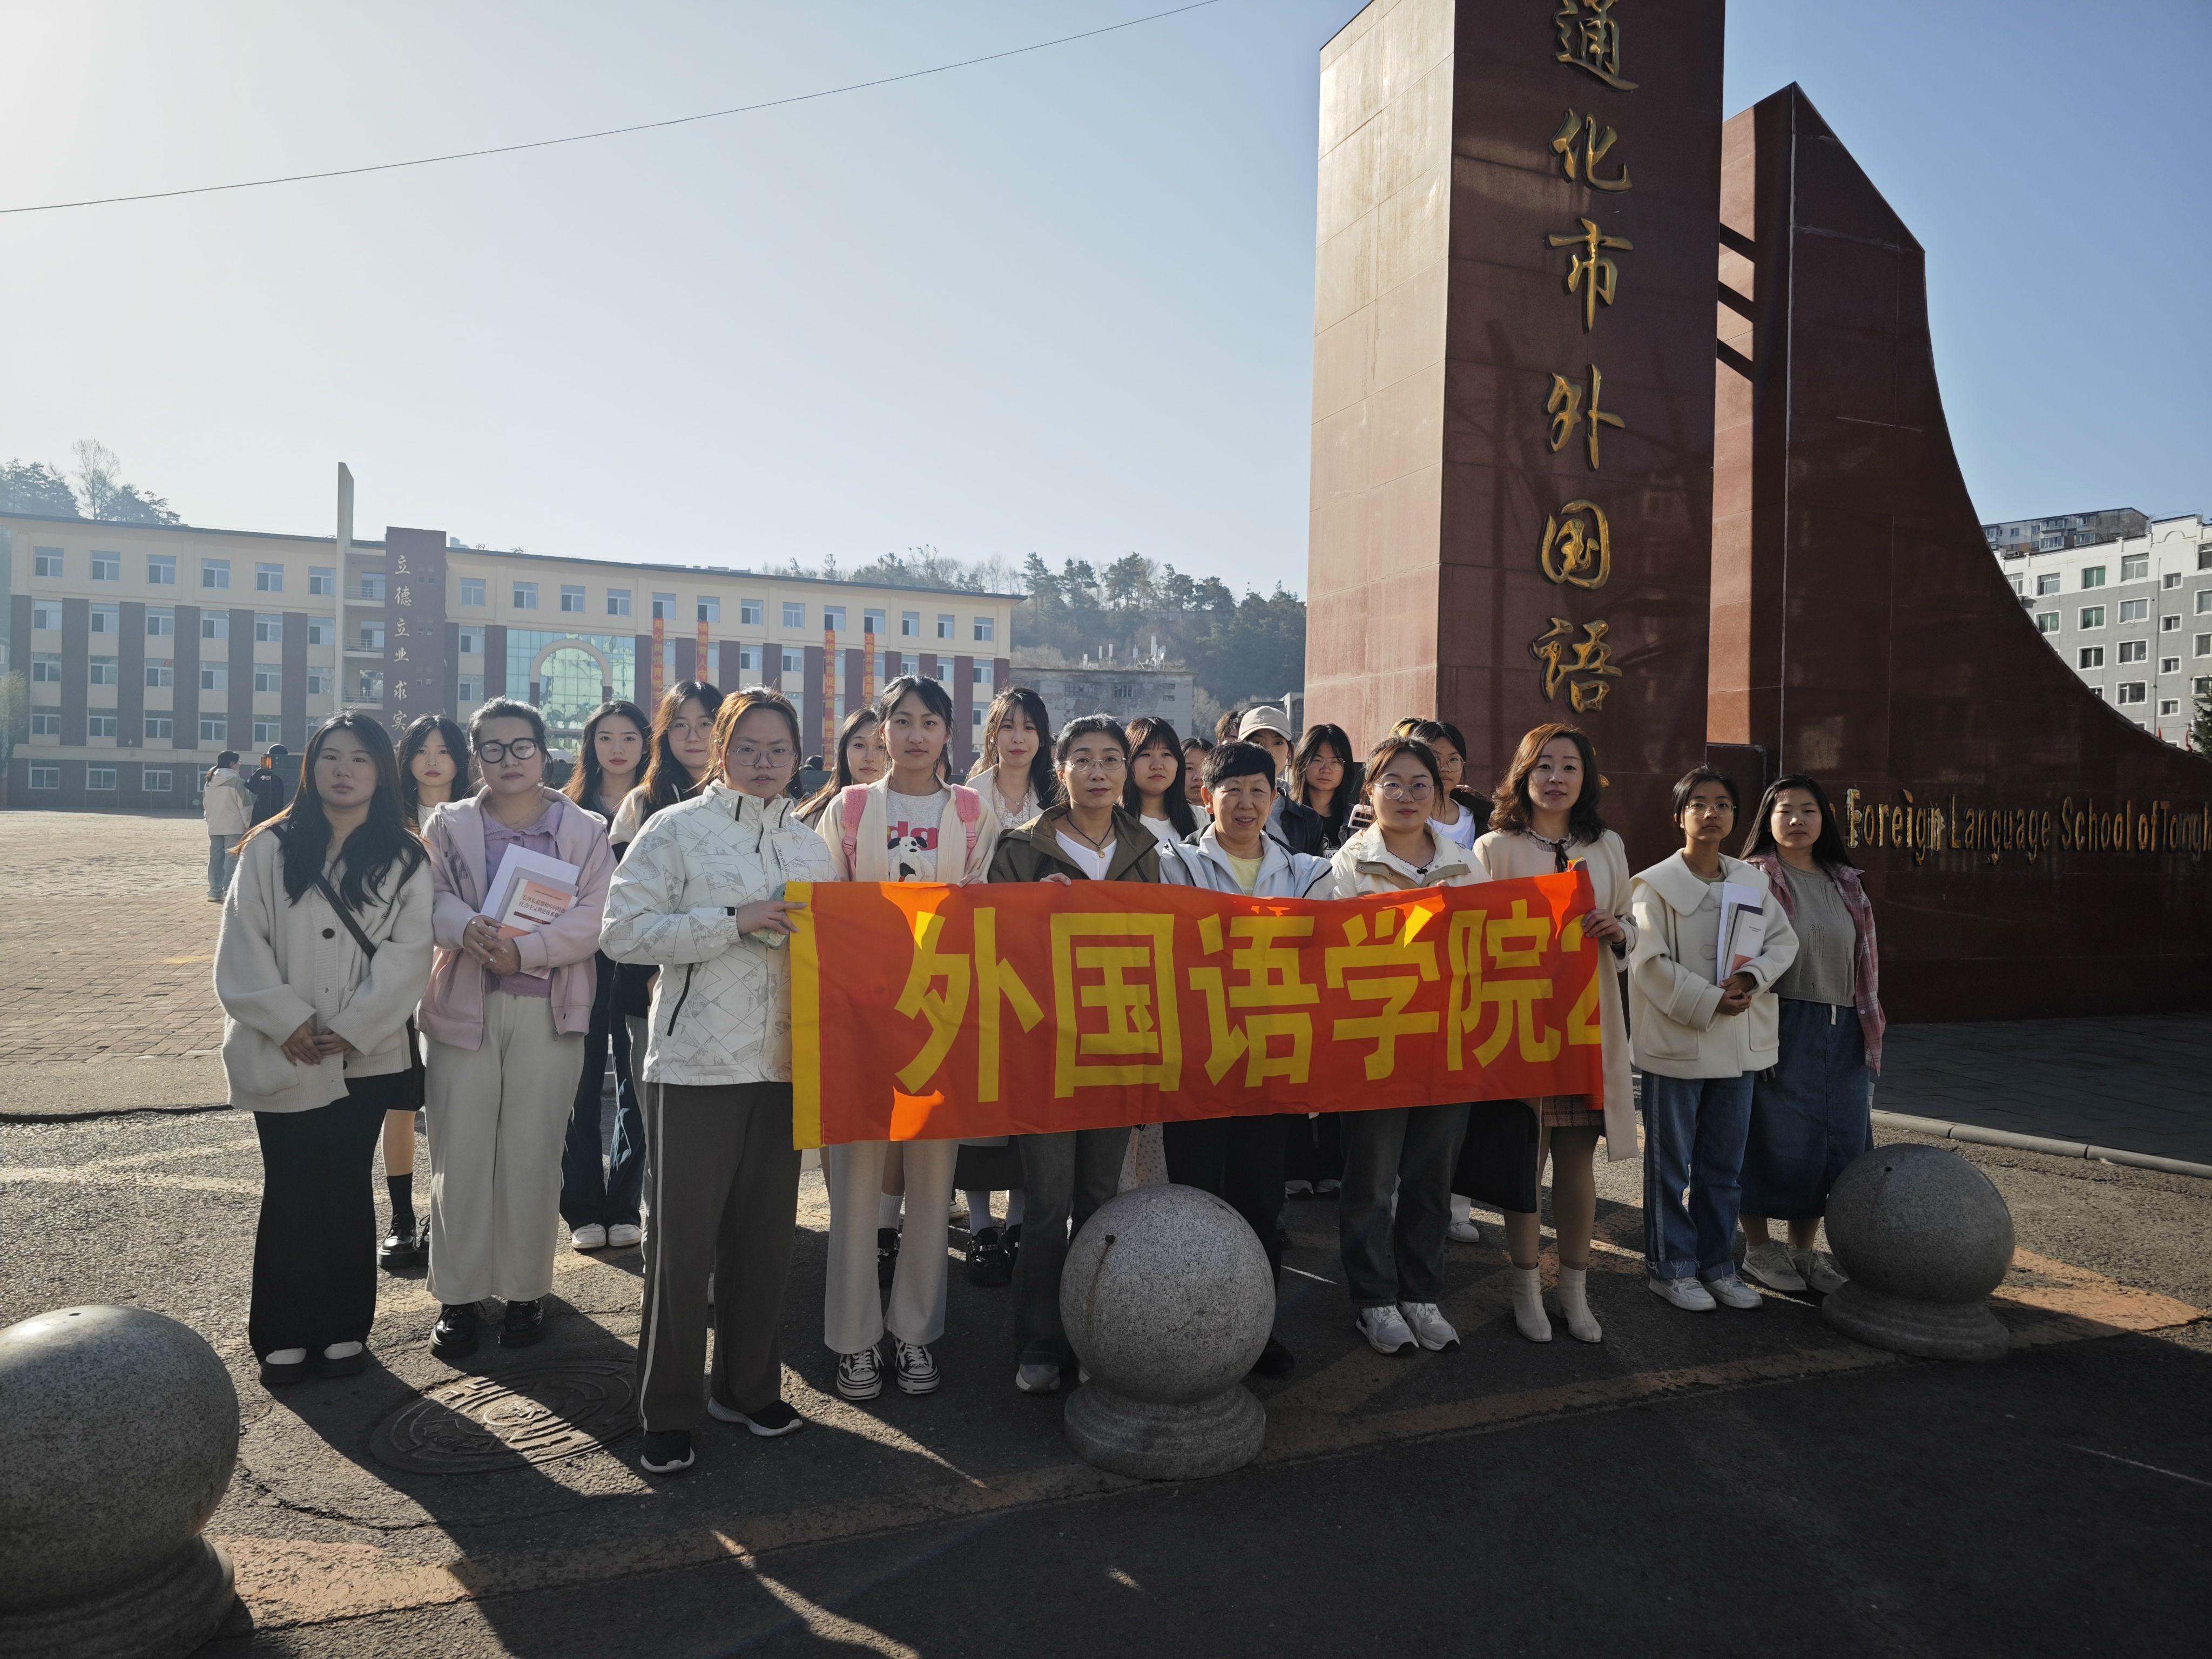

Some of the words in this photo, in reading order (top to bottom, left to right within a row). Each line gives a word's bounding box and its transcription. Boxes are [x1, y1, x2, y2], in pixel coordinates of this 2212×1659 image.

[1532, 0, 1640, 788] 通化市外国语
[1847, 788, 1943, 865] Foreign
[1950, 794, 2051, 864] Language
[2061, 797, 2131, 852] School
[2138, 800, 2159, 852] of
